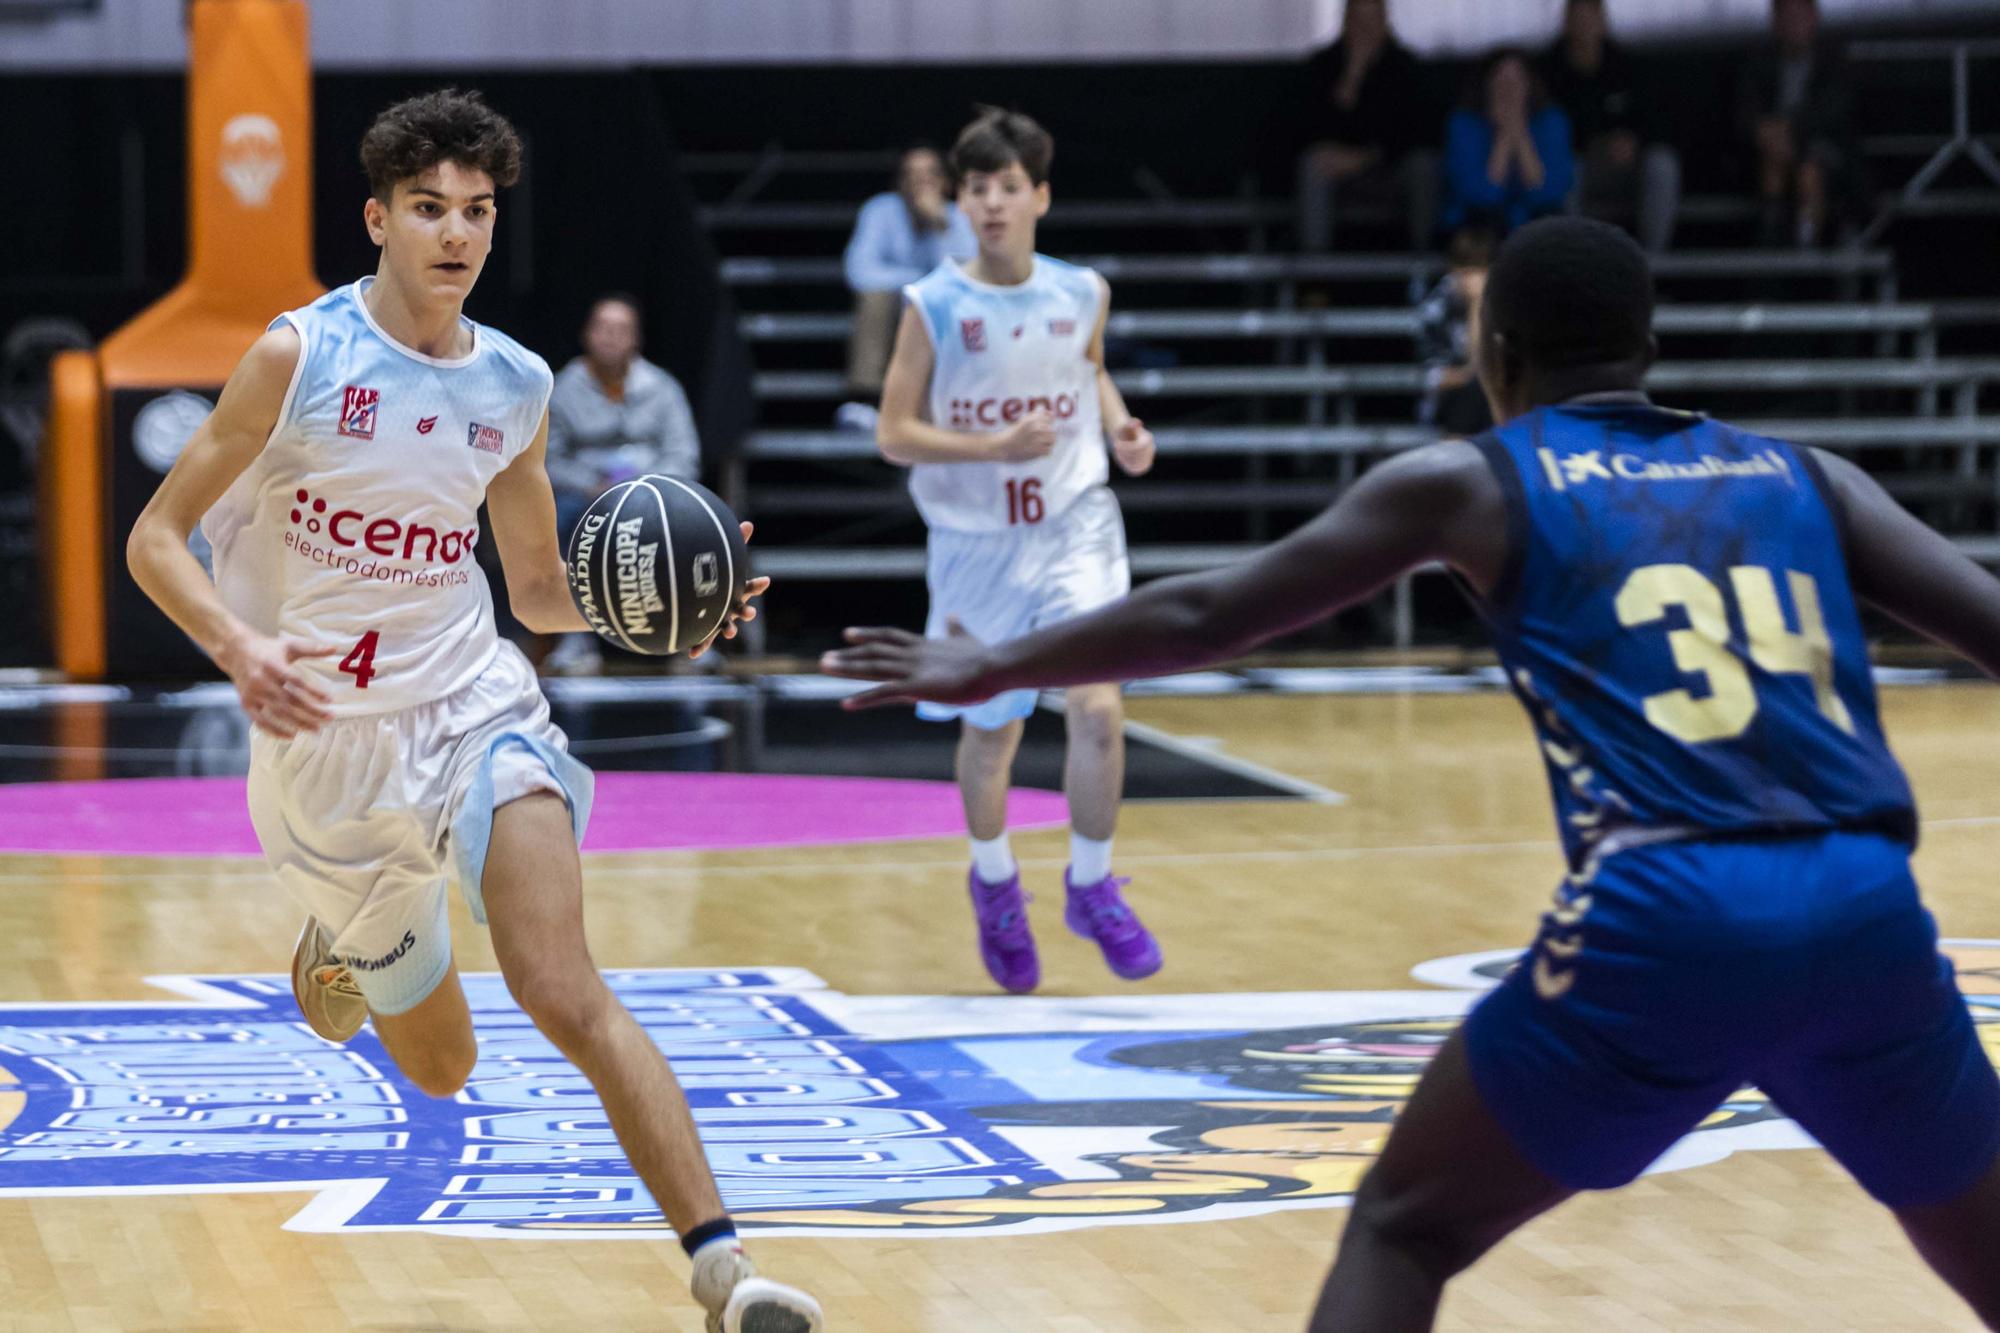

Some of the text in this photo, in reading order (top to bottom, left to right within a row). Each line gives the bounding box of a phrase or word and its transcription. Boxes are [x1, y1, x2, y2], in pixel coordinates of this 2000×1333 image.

[1004, 477, 1046, 525] 16
[615, 516, 656, 636] MINICOPA
[637, 541, 666, 614] ENDESA
[338, 629, 381, 690] 4
[1614, 562, 1856, 743] 34
